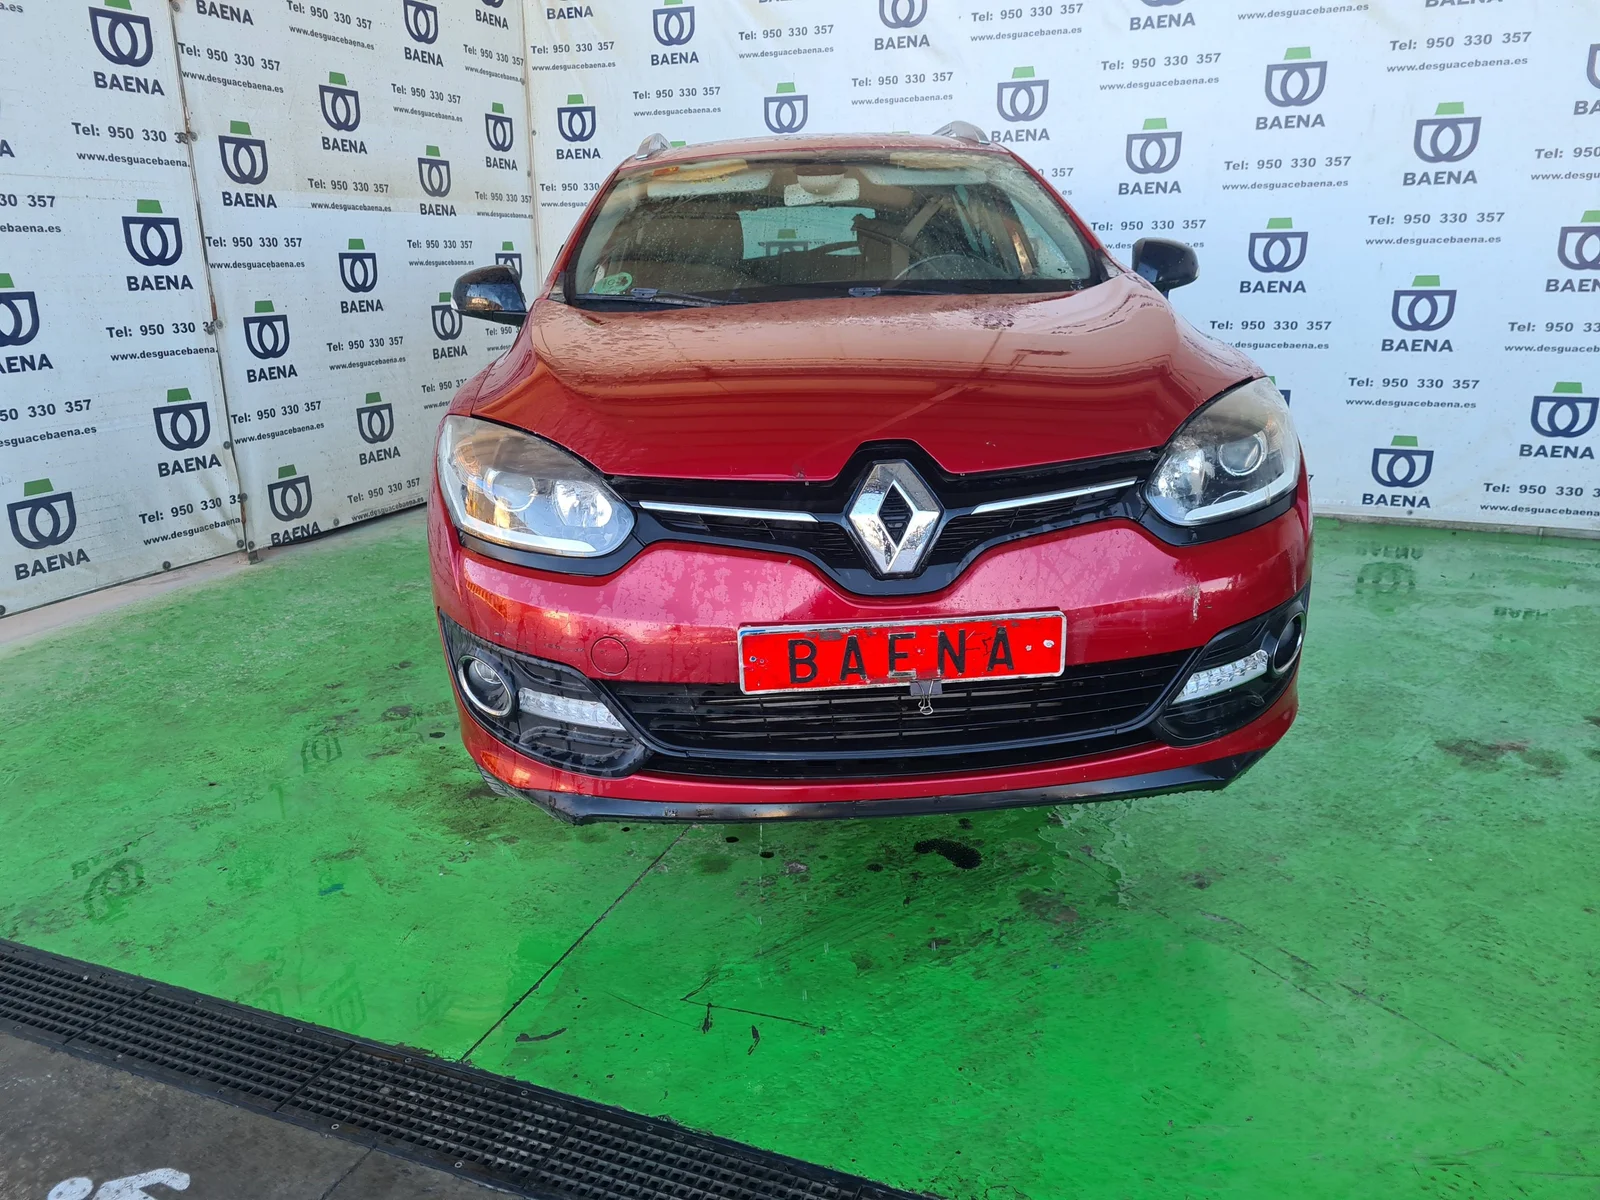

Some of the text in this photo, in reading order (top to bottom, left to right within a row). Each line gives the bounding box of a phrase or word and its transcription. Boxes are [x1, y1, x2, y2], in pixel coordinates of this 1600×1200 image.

[195, 0, 254, 26] BAENA
[310, 5, 328, 20] 950
[333, 11, 351, 25] 330
[356, 16, 372, 30] 357
[475, 8, 509, 30] BAENA
[546, 5, 593, 19] BAENA
[971, 2, 1083, 22] Tel: 950 330 357
[1237, 3, 1369, 20] www.desguacebaena.es
[1129, 12, 1195, 31] BAENA
[288, 25, 374, 50] www.desguacebaena.es
[738, 24, 834, 41] Tel: 950 330 357
[970, 27, 1082, 42] www.desguacebaena.es
[531, 41, 614, 55] Tel: 950 330 357
[874, 34, 930, 51] BAENA
[1389, 31, 1532, 51] Tel: 950 330 357
[178, 42, 280, 71] Tel: 950 330 357
[404, 46, 443, 67] BAENA
[650, 51, 699, 66] BAENA
[738, 46, 834, 59] www.desguacebaena.es
[532, 62, 616, 72] www.desguacebaena.es
[1101, 52, 1221, 71] Tel: 950 330 357
[1386, 57, 1528, 72] www.desguacebaena.es
[93, 70, 165, 96] BAENA
[182, 69, 284, 93] www.desguacebaena.es
[851, 71, 953, 87] Tel: 950 330 357
[1099, 76, 1219, 91] www.desguacebaena.es
[390, 82, 461, 104] Tel: 950 330 357
[632, 86, 720, 100] Tel: 950 330 357
[851, 94, 953, 105] www.desguacebaena.es
[392, 106, 463, 122] www.desguacebaena.es
[633, 107, 721, 117] www.desguacebaena.es
[1255, 113, 1325, 130] BAENA
[71, 122, 100, 136] Tel:
[107, 125, 134, 140] 950
[141, 128, 167, 142] 330
[991, 128, 1050, 144] BAENA
[321, 136, 367, 154] BAENA
[556, 147, 601, 159] BAENA
[485, 155, 518, 171] BAENA
[1224, 155, 1351, 170] Tel: 950 330 357
[307, 177, 389, 193] Tel: 950 330 357
[1222, 180, 1348, 191] www.desguacebaena.es
[1402, 170, 1477, 186] BAENA
[1118, 180, 1181, 195] BAENA
[221, 191, 277, 208] BAENA
[310, 201, 392, 212] www.desguacebaena.es
[419, 203, 457, 216] BAENA
[1091, 219, 1206, 232] Tel: 950 330 357
[1368, 212, 1505, 225] Tel: 950 330 357
[205, 236, 302, 248] Tel: 950 330 357
[406, 239, 472, 249] Tel: 950 330 357
[1365, 235, 1501, 246] www.desguacebaena.es
[209, 259, 305, 271] www.desguacebaena.es
[126, 274, 193, 291] BAENA
[1239, 280, 1306, 293] BAENA
[340, 299, 384, 314] BAENA
[105, 325, 132, 338] Tel:
[139, 323, 164, 336] 950
[171, 321, 195, 334] 330
[1209, 320, 1332, 330] Tel: 950 330 357
[1508, 321, 1573, 332] Tel: 950
[326, 335, 403, 352] Tel: 950 330 357
[1381, 338, 1453, 352] BAENA
[432, 344, 468, 360] BAENA
[328, 356, 406, 371] www.desguacebaena.es
[246, 364, 298, 383] BAENA
[1348, 377, 1480, 389] Tel: 950 330 357
[27, 398, 91, 418] 330 357
[1345, 398, 1476, 408] www.desguacebaena.es
[231, 400, 321, 425] Tel: 950 330 357
[234, 422, 325, 445] www.desguacebaena.es
[359, 446, 401, 465] BAENA
[1519, 444, 1594, 459] BAENA
[157, 453, 222, 478] BAENA
[346, 477, 420, 504] Tel: 950 330 357
[1483, 482, 1583, 497] Tel: 950 330
[1361, 493, 1430, 508] BAENA
[138, 510, 164, 524] Tel:
[170, 503, 193, 517] 950
[200, 497, 222, 511] 330
[271, 521, 322, 546] BAENA
[14, 548, 90, 580] BAENA
[787, 626, 1015, 684] BAENA
